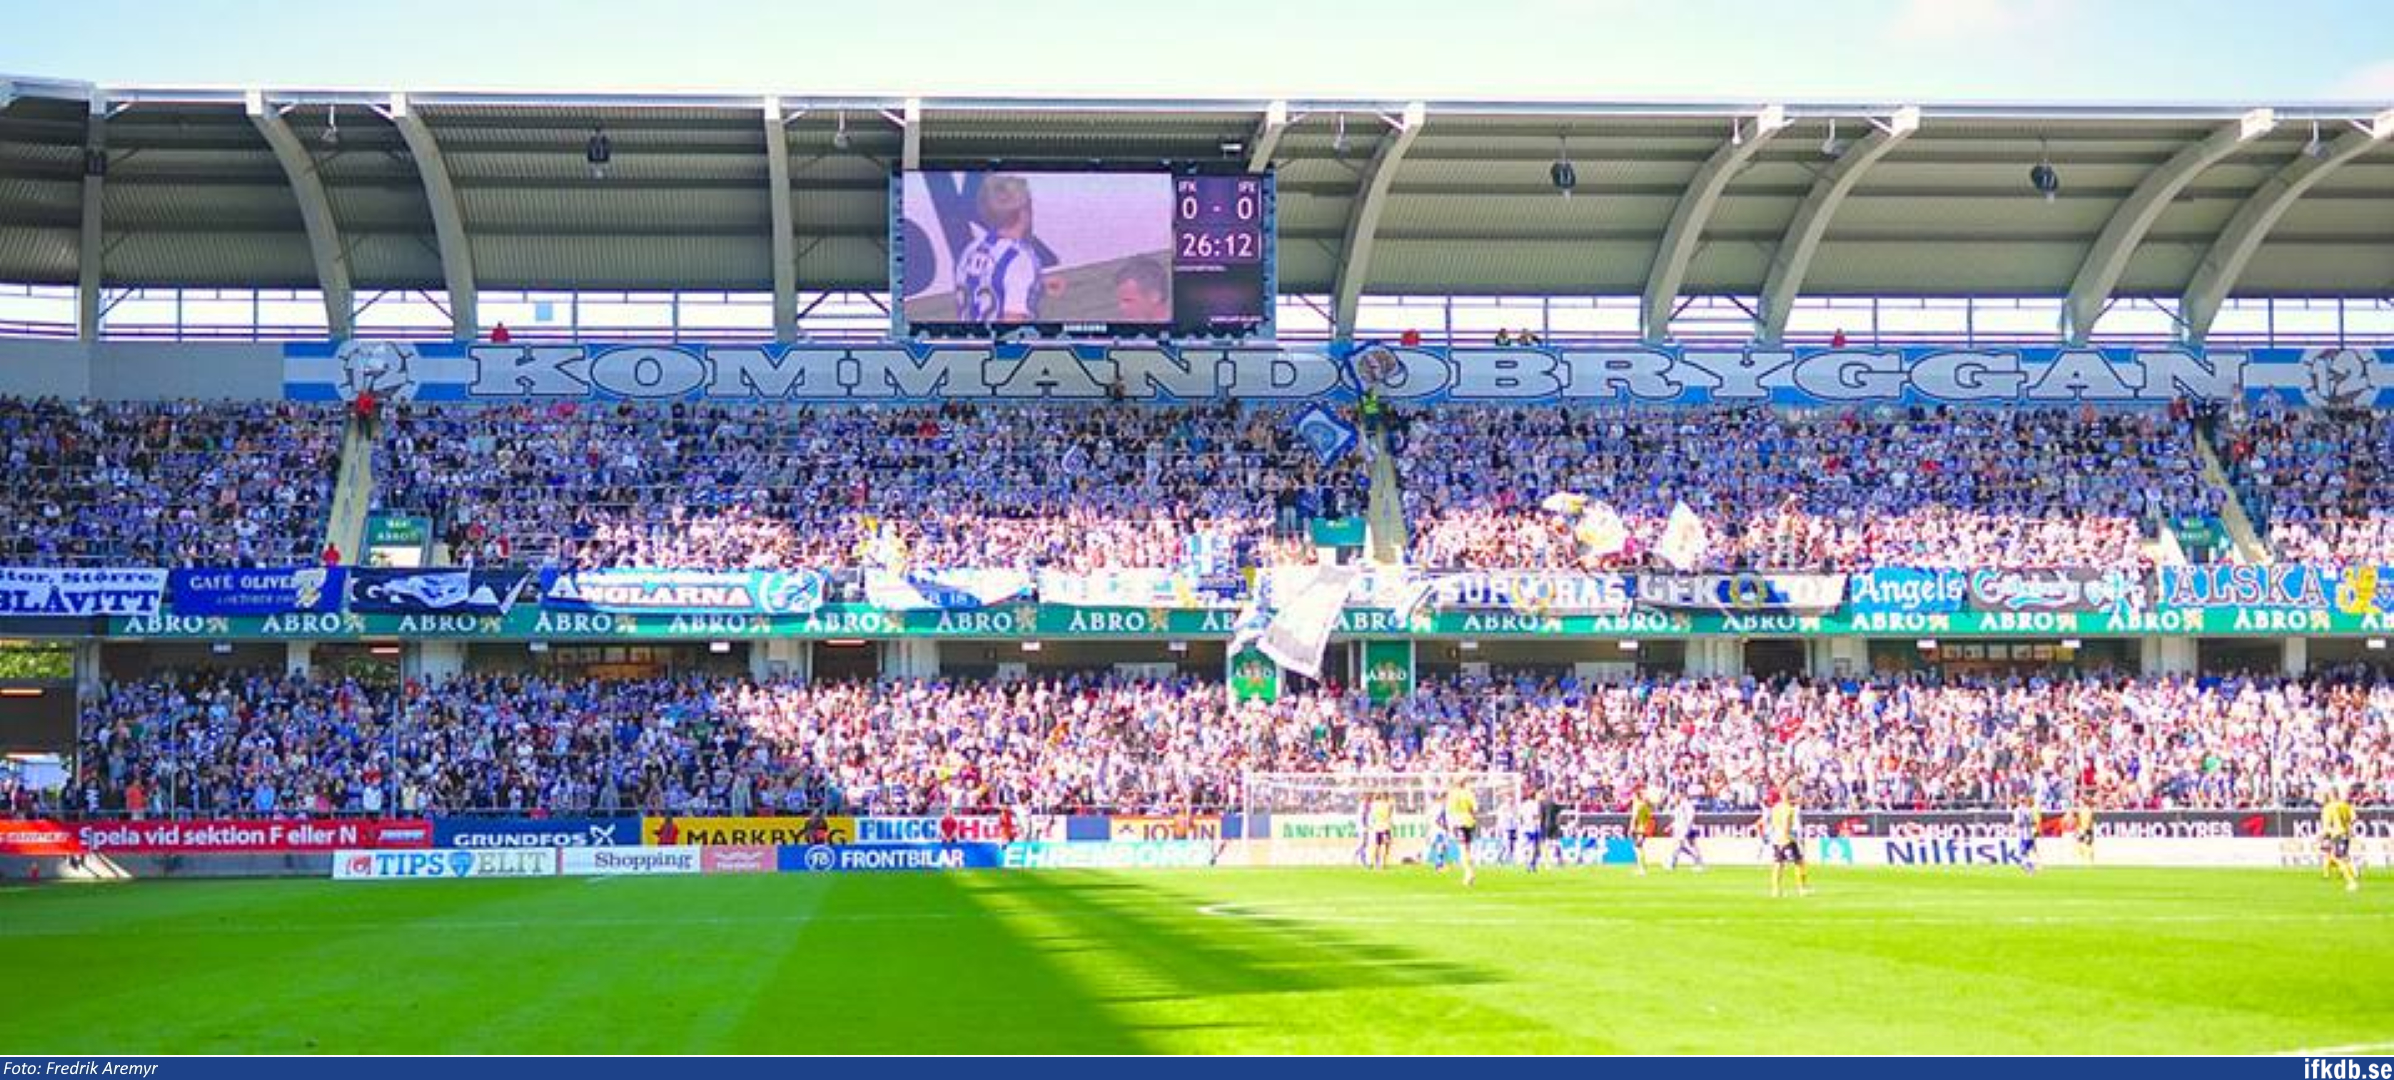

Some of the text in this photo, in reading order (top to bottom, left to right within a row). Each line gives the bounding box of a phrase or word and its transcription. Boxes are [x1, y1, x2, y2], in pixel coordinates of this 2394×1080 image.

[1183, 196, 1197, 219] 0
[1238, 196, 1252, 219] 0
[1183, 233, 1253, 257] 26:12
[466, 345, 2248, 399] KOMMANDOBRYGGAN
[1851, 570, 1966, 609] Angels
[79, 826, 139, 849] Spela
[143, 825, 179, 846] vid
[183, 825, 264, 846] sektion
[270, 826, 284, 845] F
[287, 825, 336, 846] eller
[340, 826, 357, 845] N
[454, 832, 588, 847] GRUNDFOS
[687, 829, 847, 845] MARKBYG
[2169, 821, 2233, 838] TYRES
[594, 851, 694, 870] Shopping
[841, 849, 965, 868] FRONTBILAR
[1886, 838, 2023, 865] Nilfisk
[376, 852, 546, 876] TIPS ELIT
